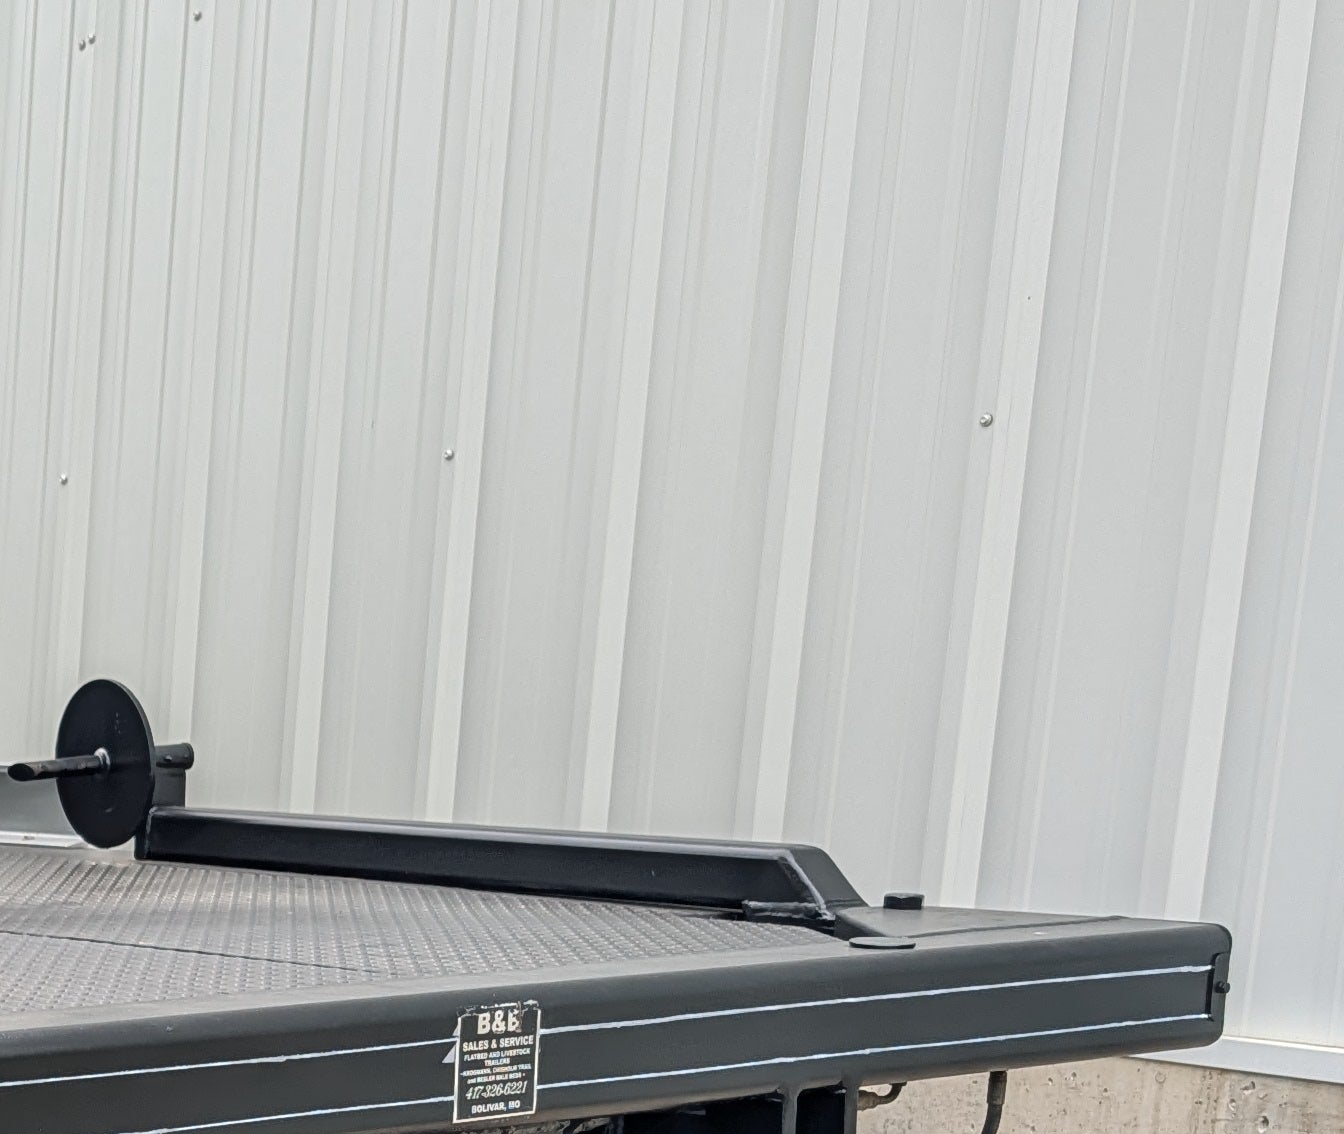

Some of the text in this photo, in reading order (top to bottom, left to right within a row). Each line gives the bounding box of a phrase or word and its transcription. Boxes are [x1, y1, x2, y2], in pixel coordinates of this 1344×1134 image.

[462, 1035, 534, 1052] SALES & SERVICE
[465, 1081, 529, 1100] 417-326-6221
[472, 1100, 521, 1114] BOLIVAR, MO
